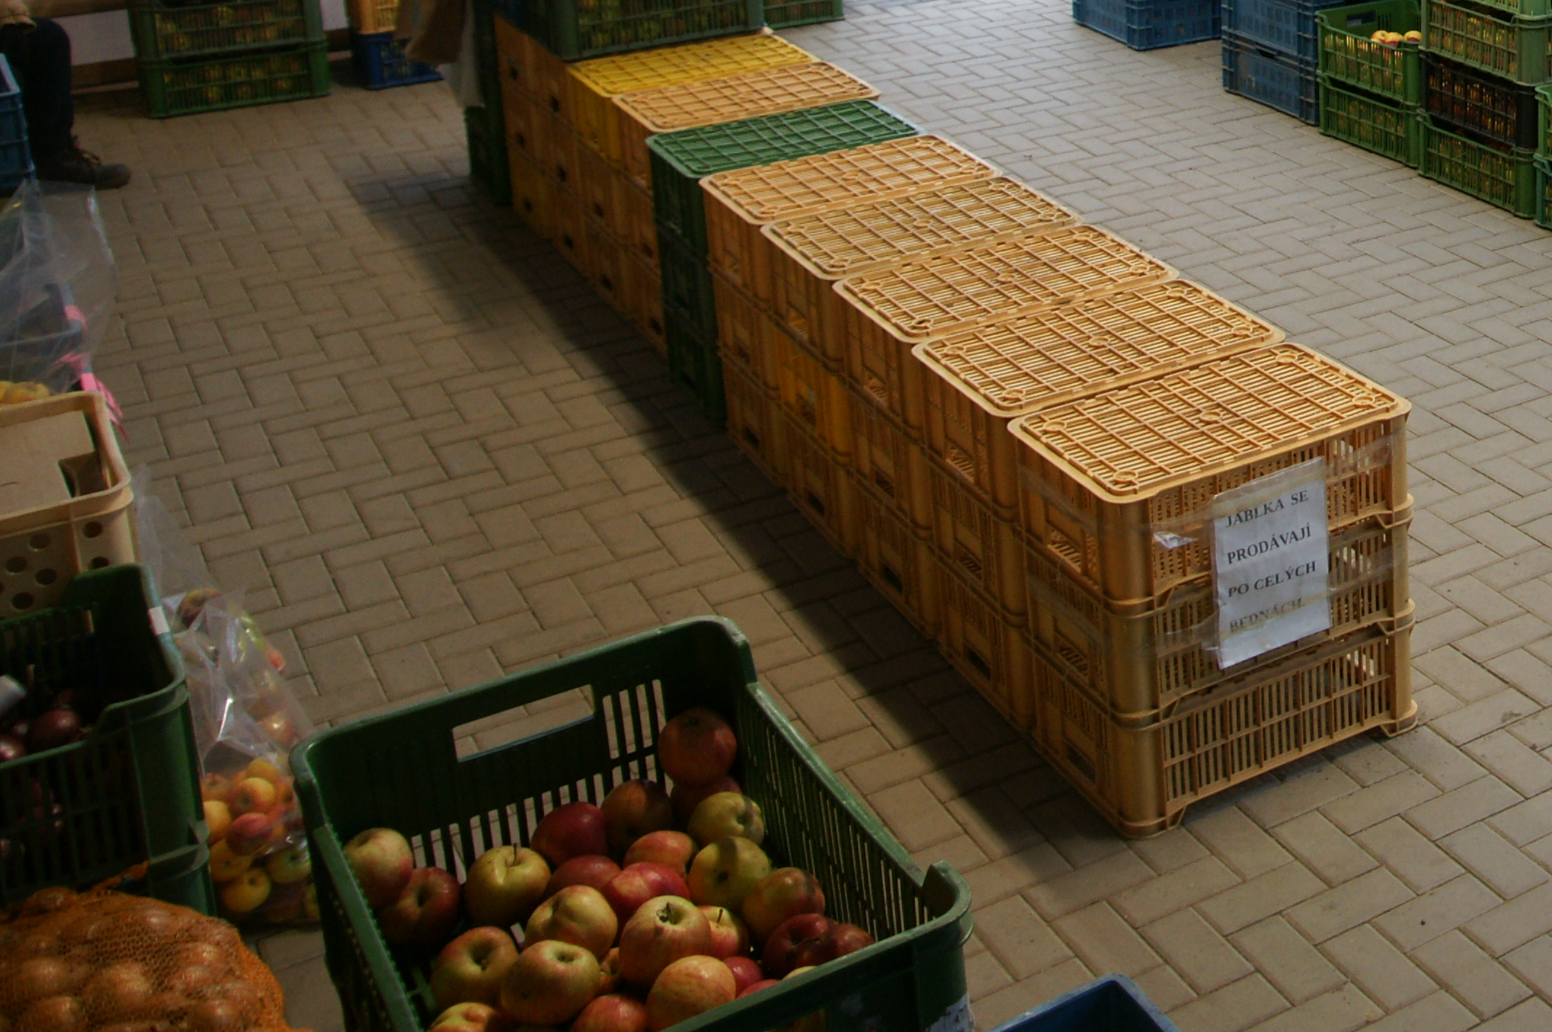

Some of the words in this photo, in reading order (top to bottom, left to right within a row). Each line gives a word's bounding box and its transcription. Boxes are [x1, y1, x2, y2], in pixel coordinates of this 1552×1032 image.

[1225, 498, 1284, 528] JABLKA
[1290, 489, 1309, 506] SE
[1227, 521, 1312, 564] PRODÁVAJÍ
[1228, 583, 1250, 598] PO
[1253, 561, 1316, 592] CELÝCH
